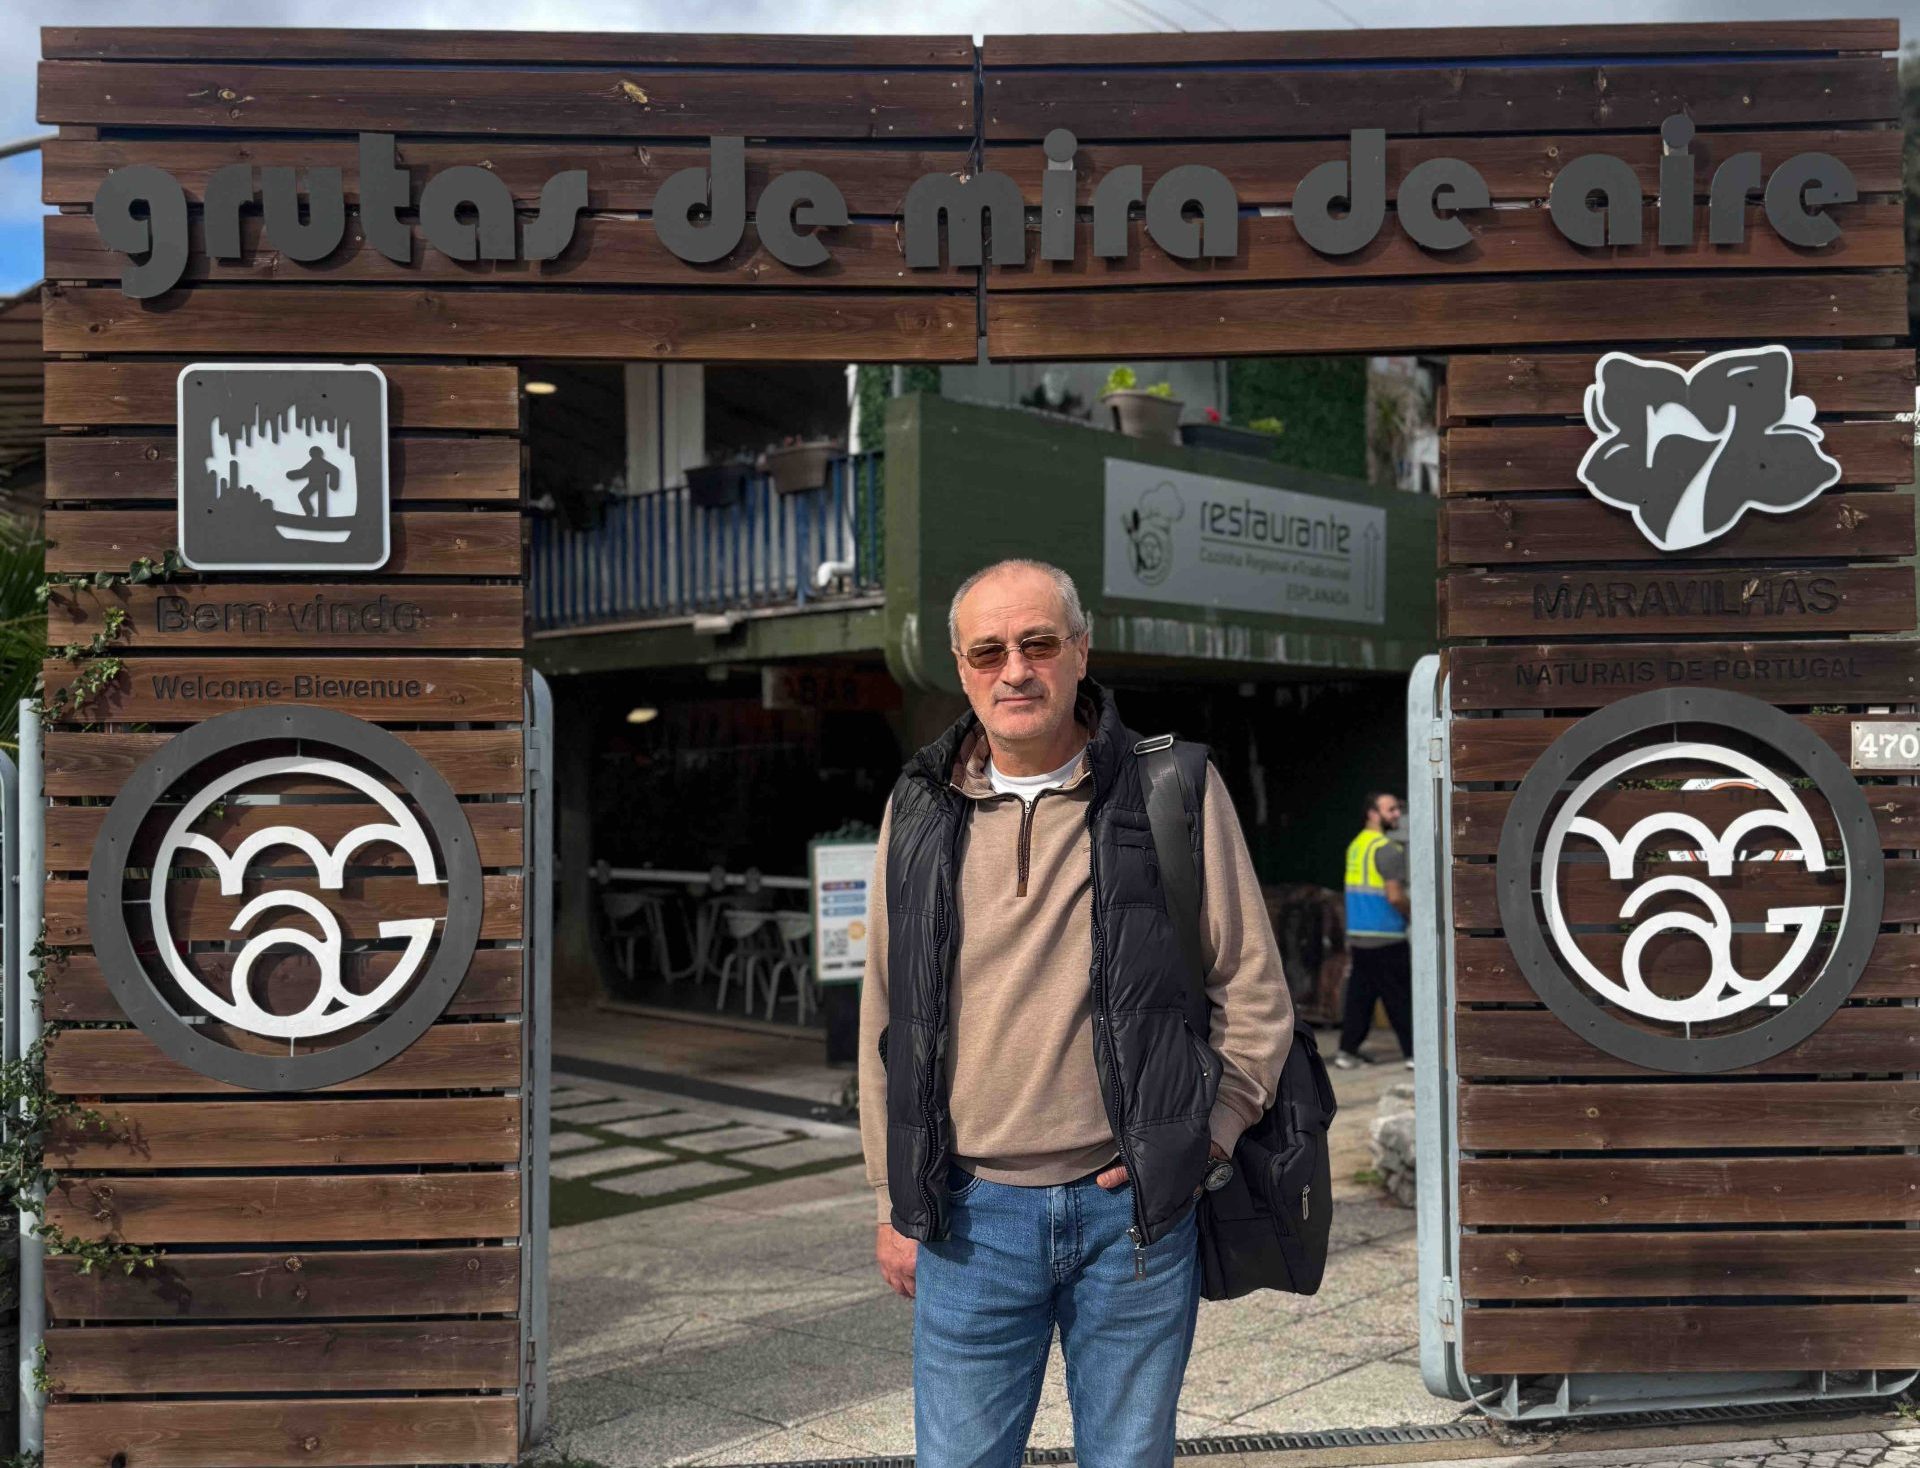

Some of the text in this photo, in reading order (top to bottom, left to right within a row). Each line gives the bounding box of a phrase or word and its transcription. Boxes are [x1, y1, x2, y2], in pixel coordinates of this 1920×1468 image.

[94, 114, 1859, 299] grutas de mira de aire
[1201, 498, 1350, 554] restaurante
[155, 594, 268, 634] Bem
[1532, 578, 1840, 621] MARAVILHAS
[151, 674, 421, 701] Welcome-Bievenue
[1516, 656, 1862, 687] NATURAIS DE PORTUGAL
[1858, 732, 1919, 759] 470
